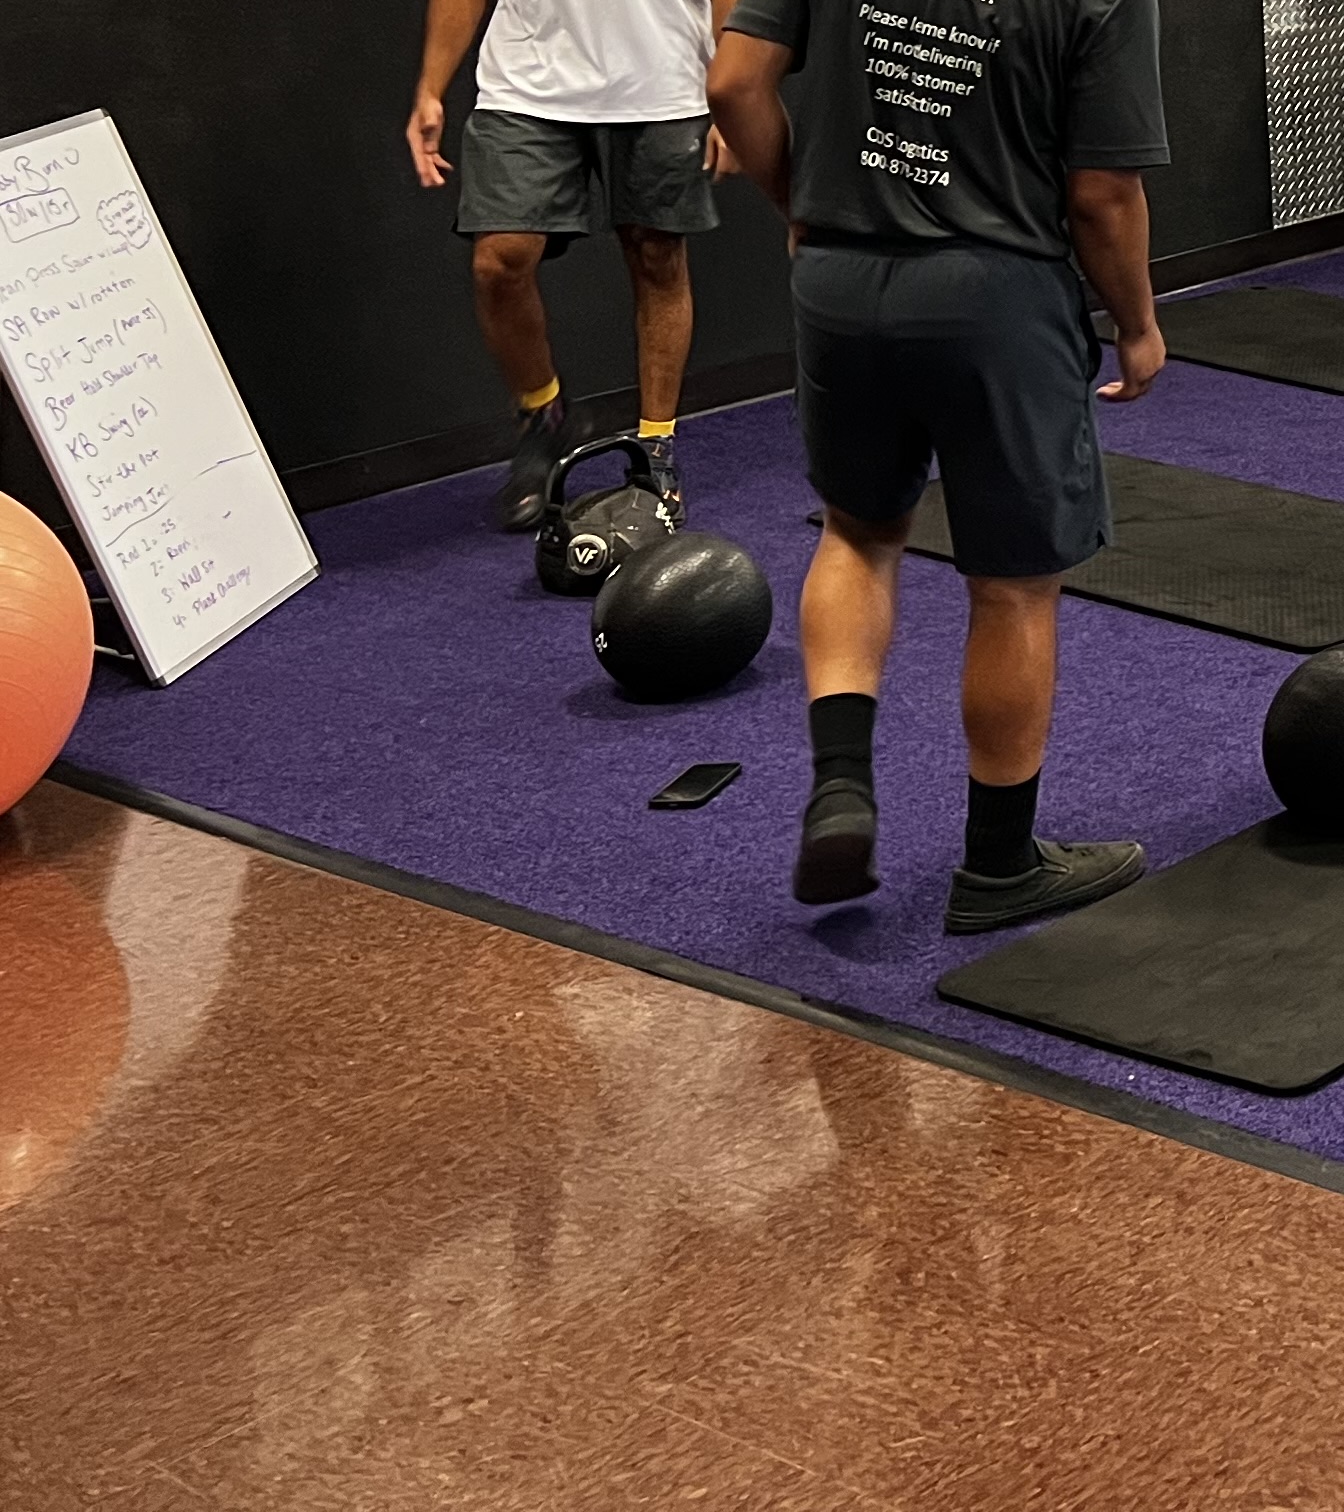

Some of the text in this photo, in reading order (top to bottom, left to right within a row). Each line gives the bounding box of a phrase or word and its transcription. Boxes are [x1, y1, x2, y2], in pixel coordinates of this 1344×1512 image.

[859, 3, 909, 32] Please
[987, 39, 1001, 55] if
[862, 32, 889, 51] I'm
[915, 44, 983, 78] elivering
[864, 57, 975, 98] 100% stomer
[65, 432, 99, 463] KB
[574, 547, 599, 565] VF
